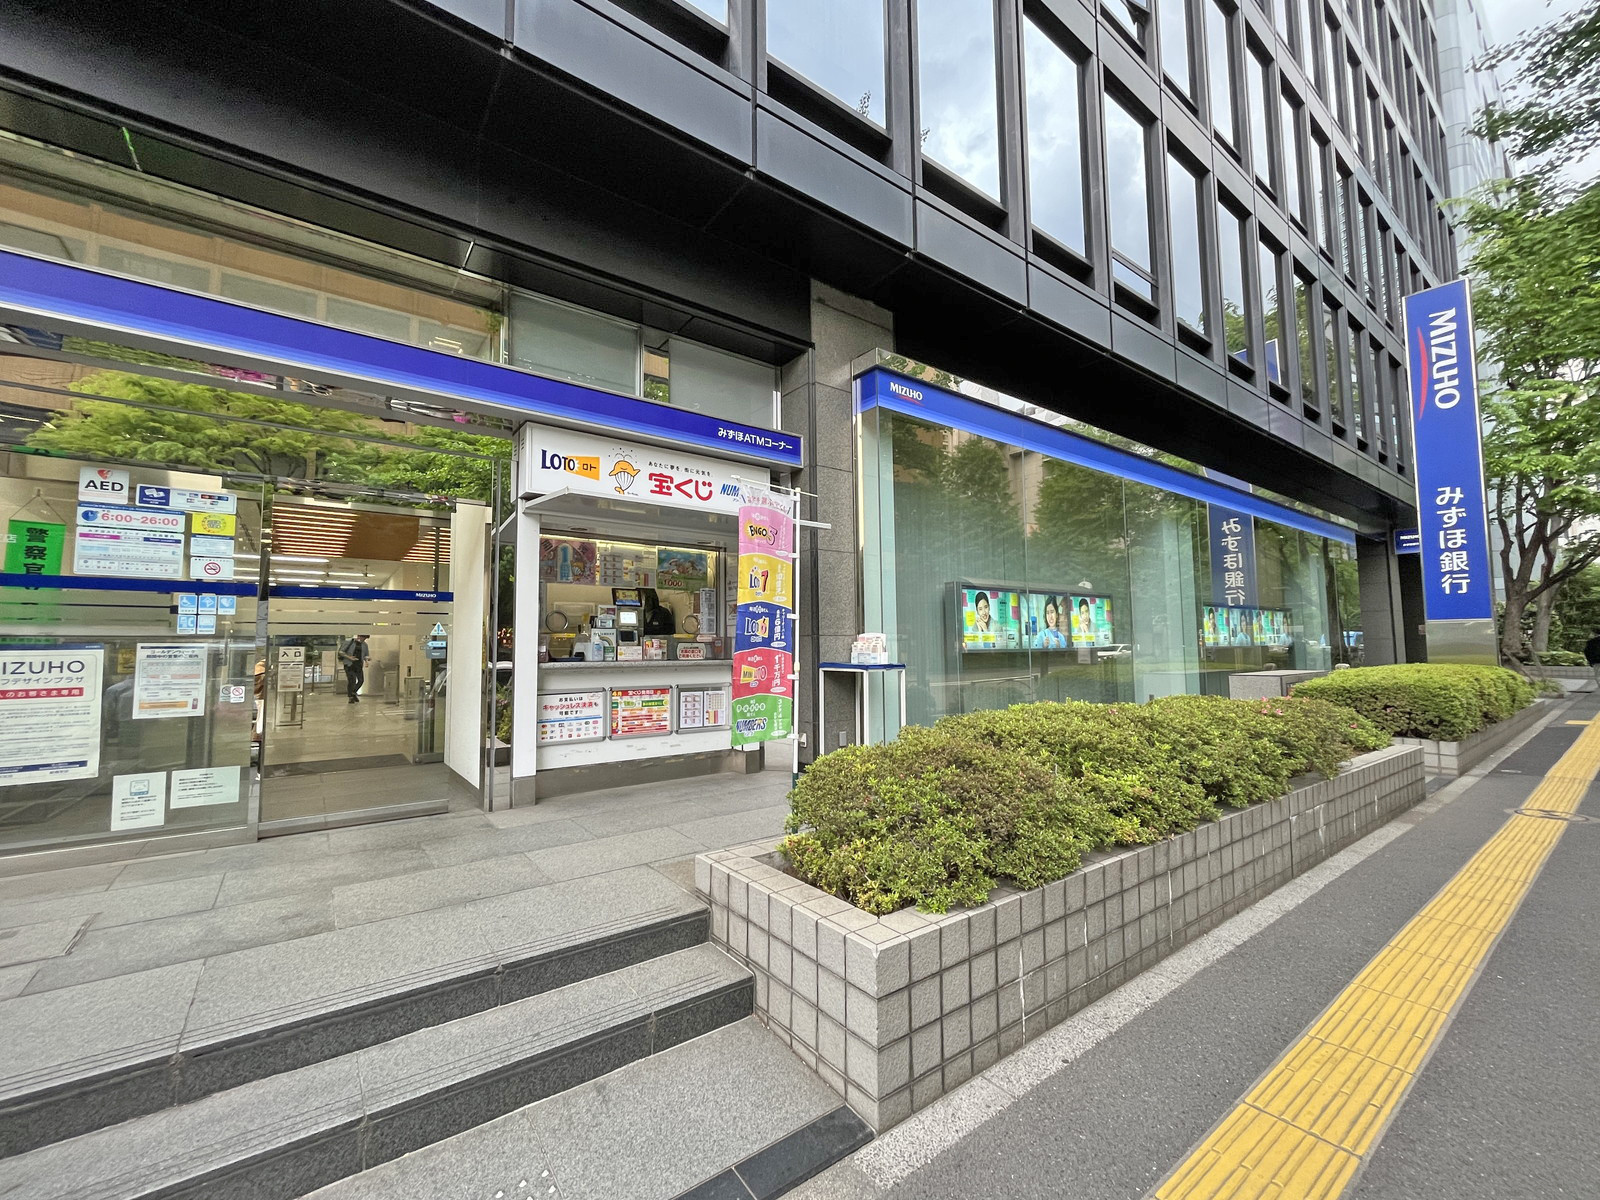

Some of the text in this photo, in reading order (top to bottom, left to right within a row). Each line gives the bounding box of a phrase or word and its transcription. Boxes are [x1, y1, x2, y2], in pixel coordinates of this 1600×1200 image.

[1429, 307, 1460, 410] MIZUHO
[890, 381, 923, 401] MIZUHO
[718, 427, 793, 450] みずほATMコーナー
[541, 449, 597, 473] LOTO ロト
[84, 480, 124, 492] AED
[648, 472, 713, 502] 宝くじ
[1435, 486, 1471, 595] みずほ銀行
[2, 660, 85, 675] IZUHO
